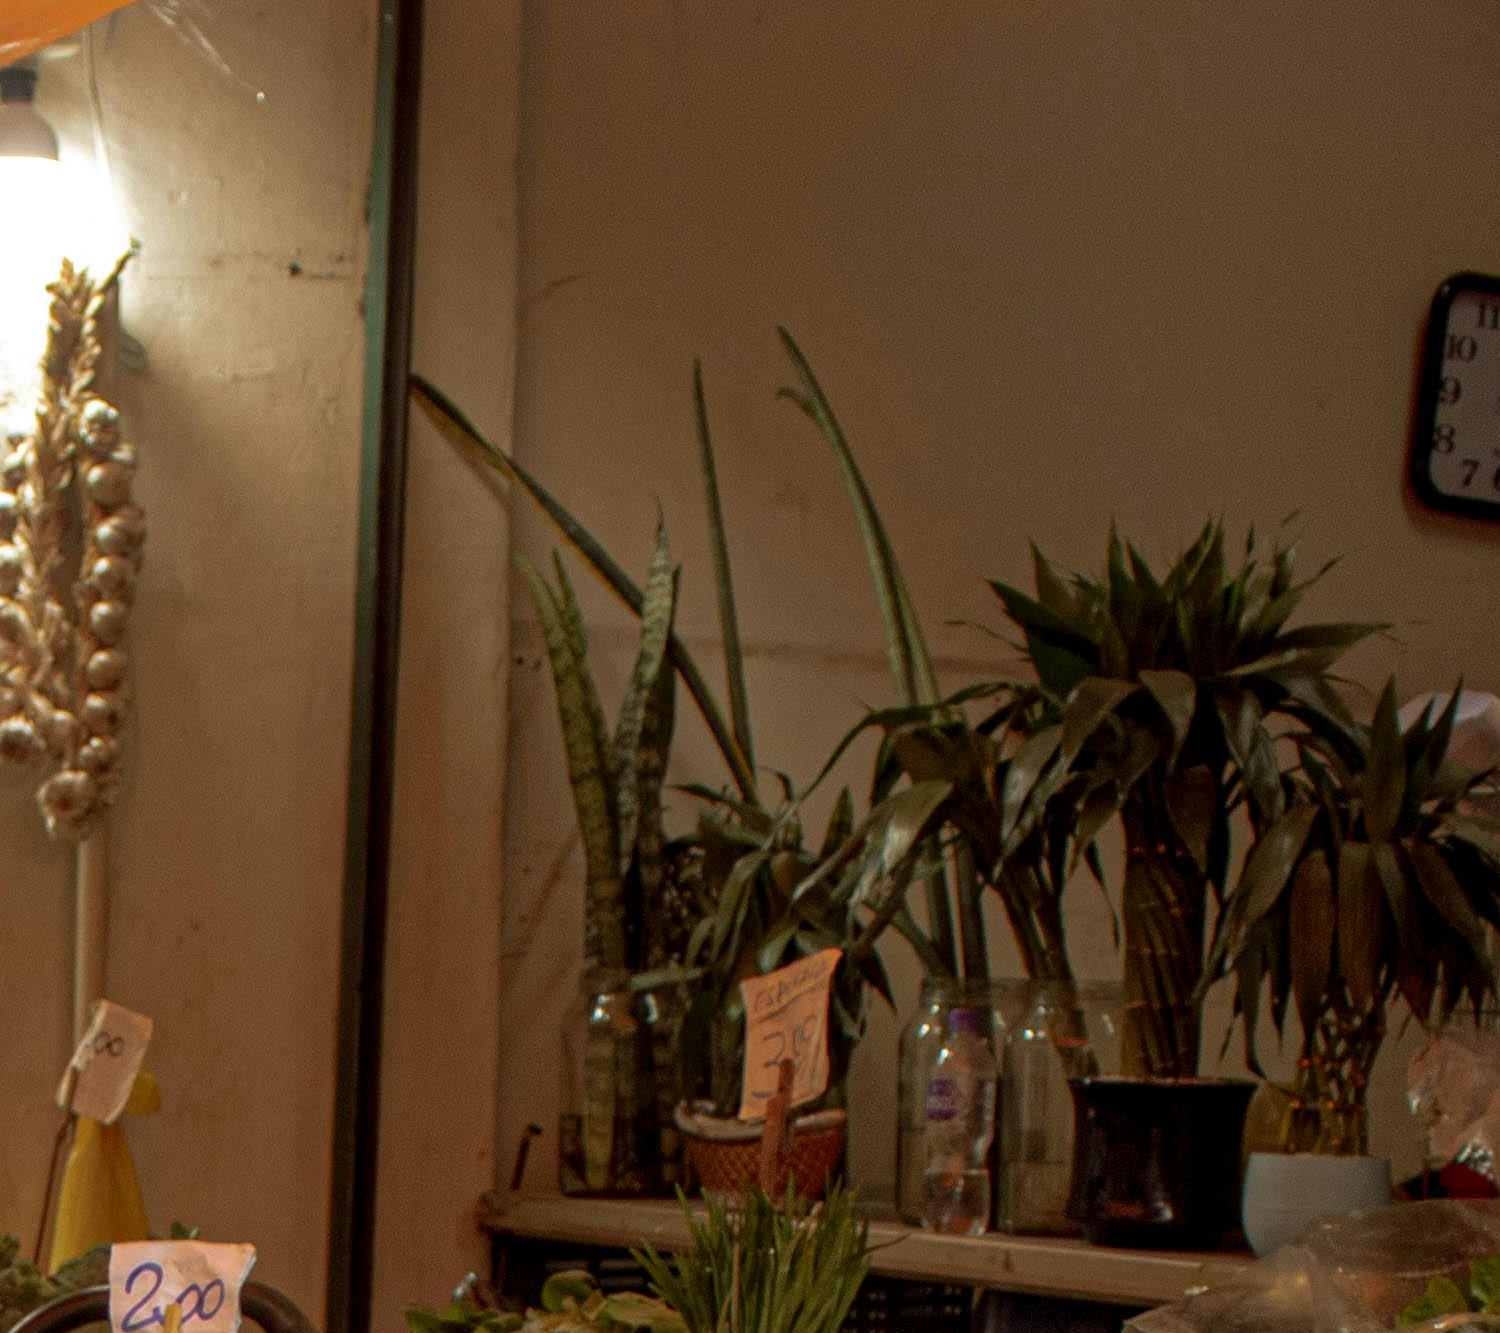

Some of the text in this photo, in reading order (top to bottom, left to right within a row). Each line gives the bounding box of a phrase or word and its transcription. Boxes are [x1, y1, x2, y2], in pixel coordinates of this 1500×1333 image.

[1478, 303, 1500, 330] 11
[1447, 334, 1478, 363] 10
[1439, 378, 1462, 405] 9
[1434, 426, 1456, 454] 8
[1462, 460, 1480, 487] 7
